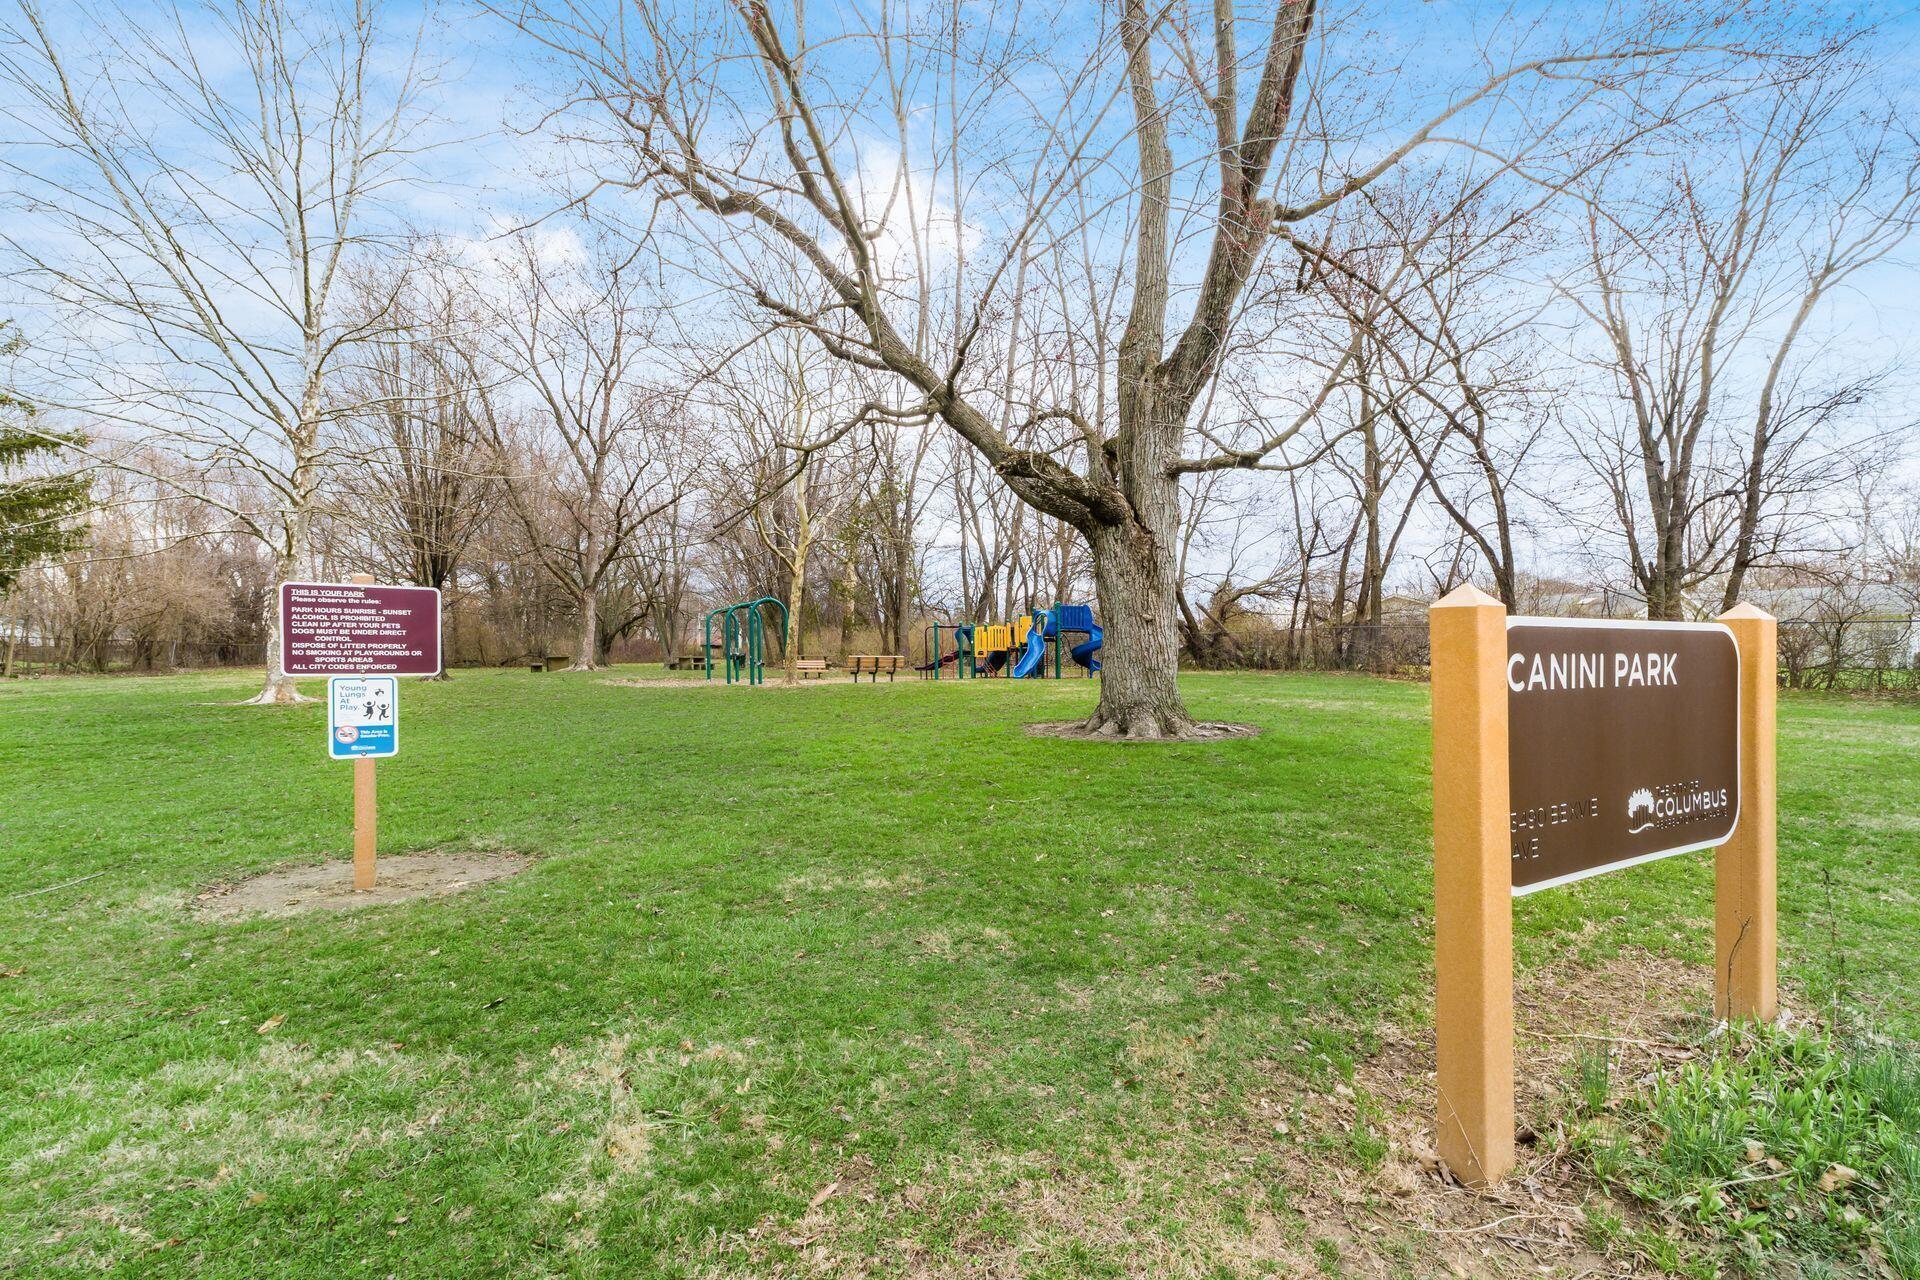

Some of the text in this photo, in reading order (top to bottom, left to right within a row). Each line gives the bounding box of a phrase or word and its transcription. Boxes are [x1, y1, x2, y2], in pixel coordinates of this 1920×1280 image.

[1508, 653, 1679, 692] CANINI PARK
[1656, 788, 1728, 818] COLUMBUS
[1512, 838, 1540, 860] AVE
